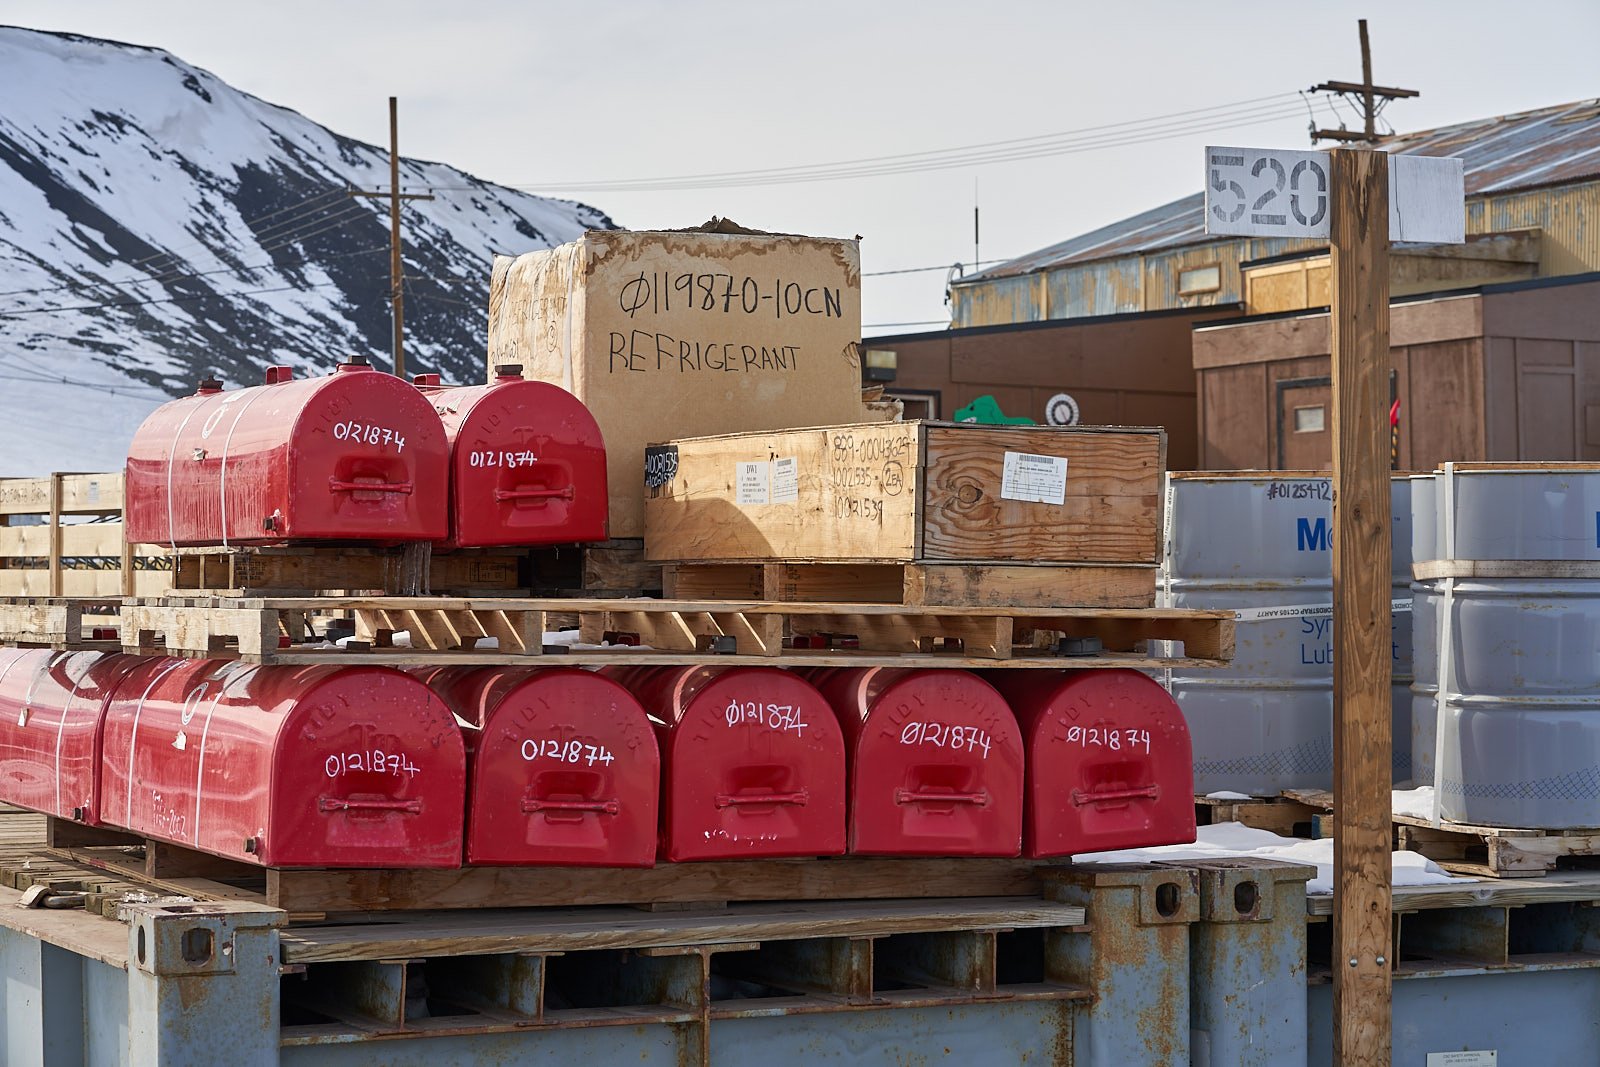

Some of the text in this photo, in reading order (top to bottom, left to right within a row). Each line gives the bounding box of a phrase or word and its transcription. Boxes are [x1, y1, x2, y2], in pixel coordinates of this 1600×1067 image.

[1211, 155, 1326, 227] 520
[609, 329, 802, 374] REFRIGERANT
[333, 420, 405, 453] 0121874
[470, 450, 538, 469] 0121874
[325, 749, 420, 778] 0121874
[520, 740, 615, 767] 0121874
